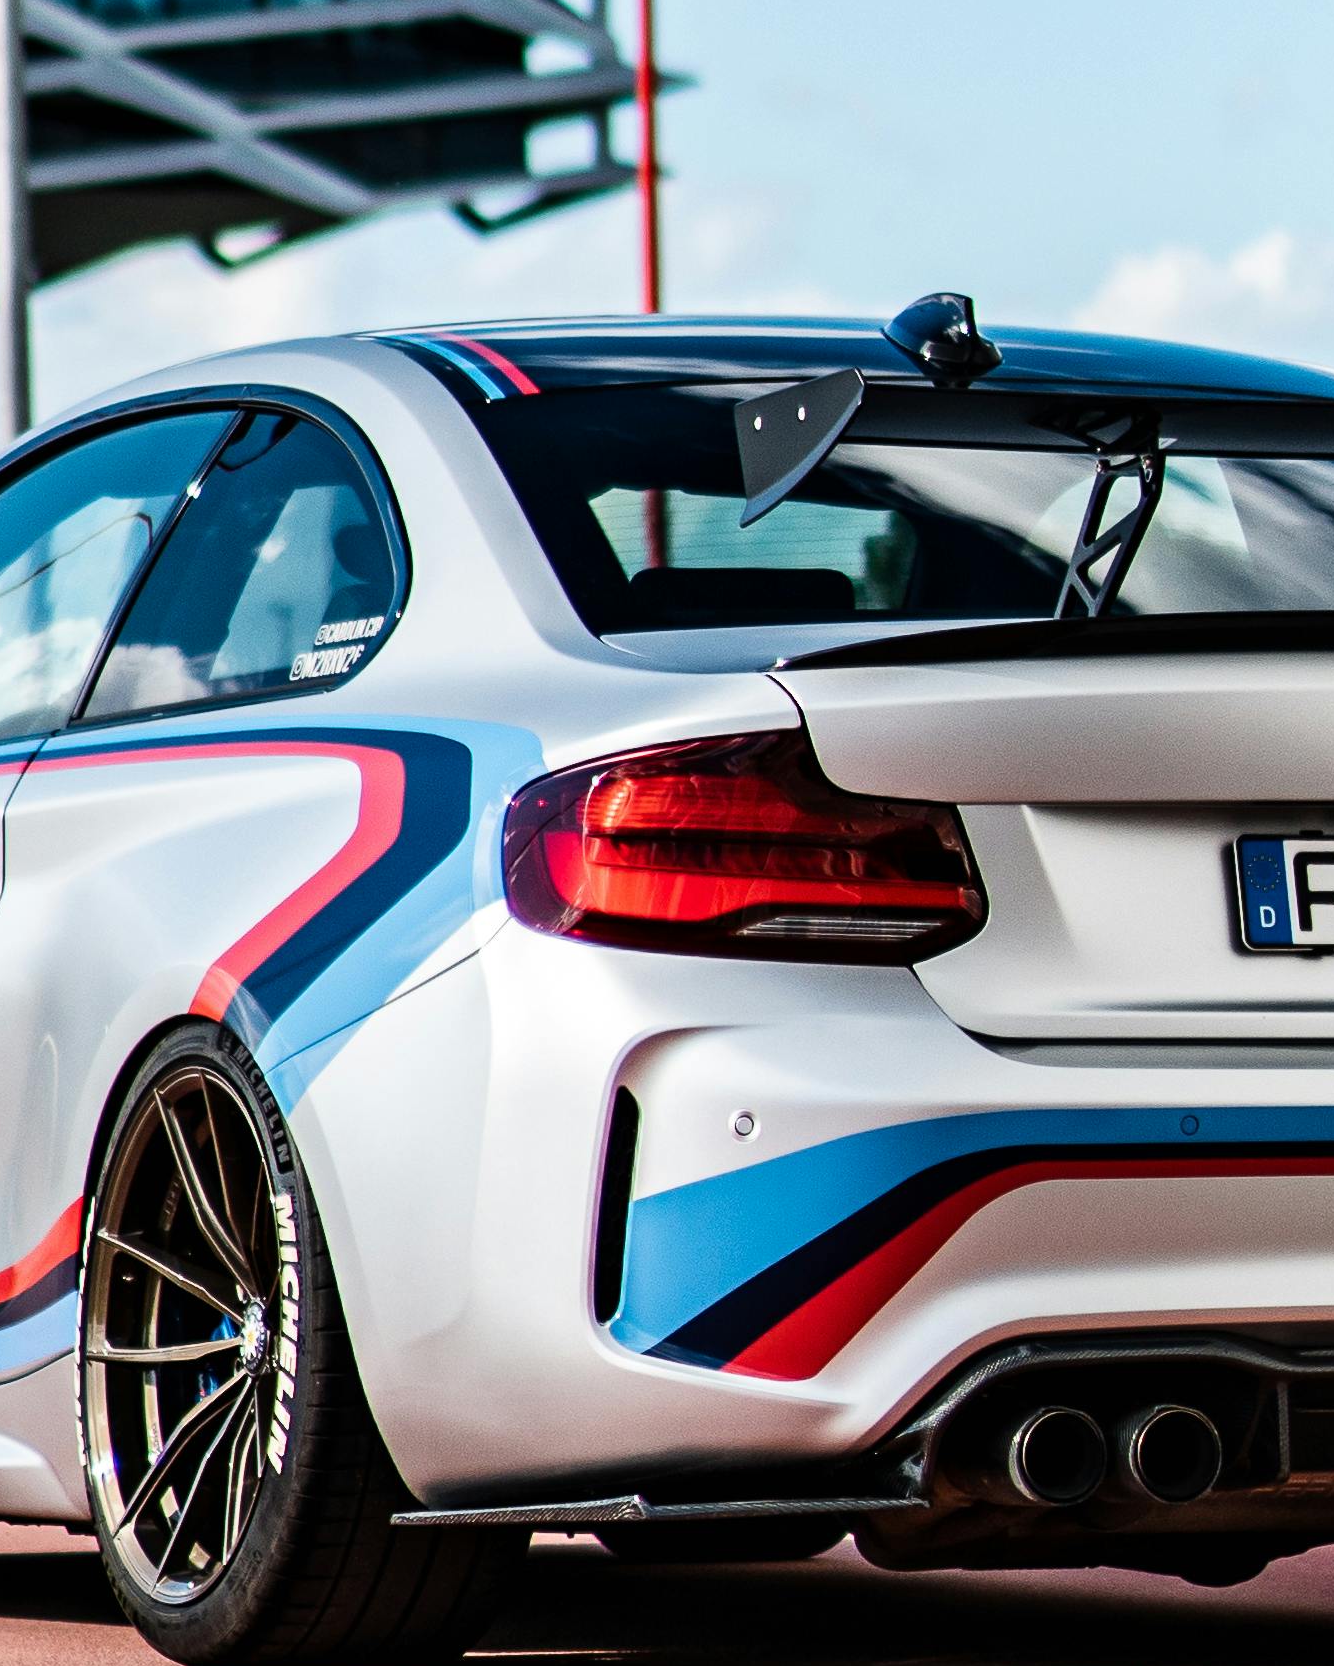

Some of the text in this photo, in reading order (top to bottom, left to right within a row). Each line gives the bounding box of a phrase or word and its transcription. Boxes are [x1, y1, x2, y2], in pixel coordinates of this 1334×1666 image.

[1259, 905, 1276, 928] D
[233, 1043, 290, 1164] MICHELIN
[267, 1192, 300, 1475] MICHELIN
